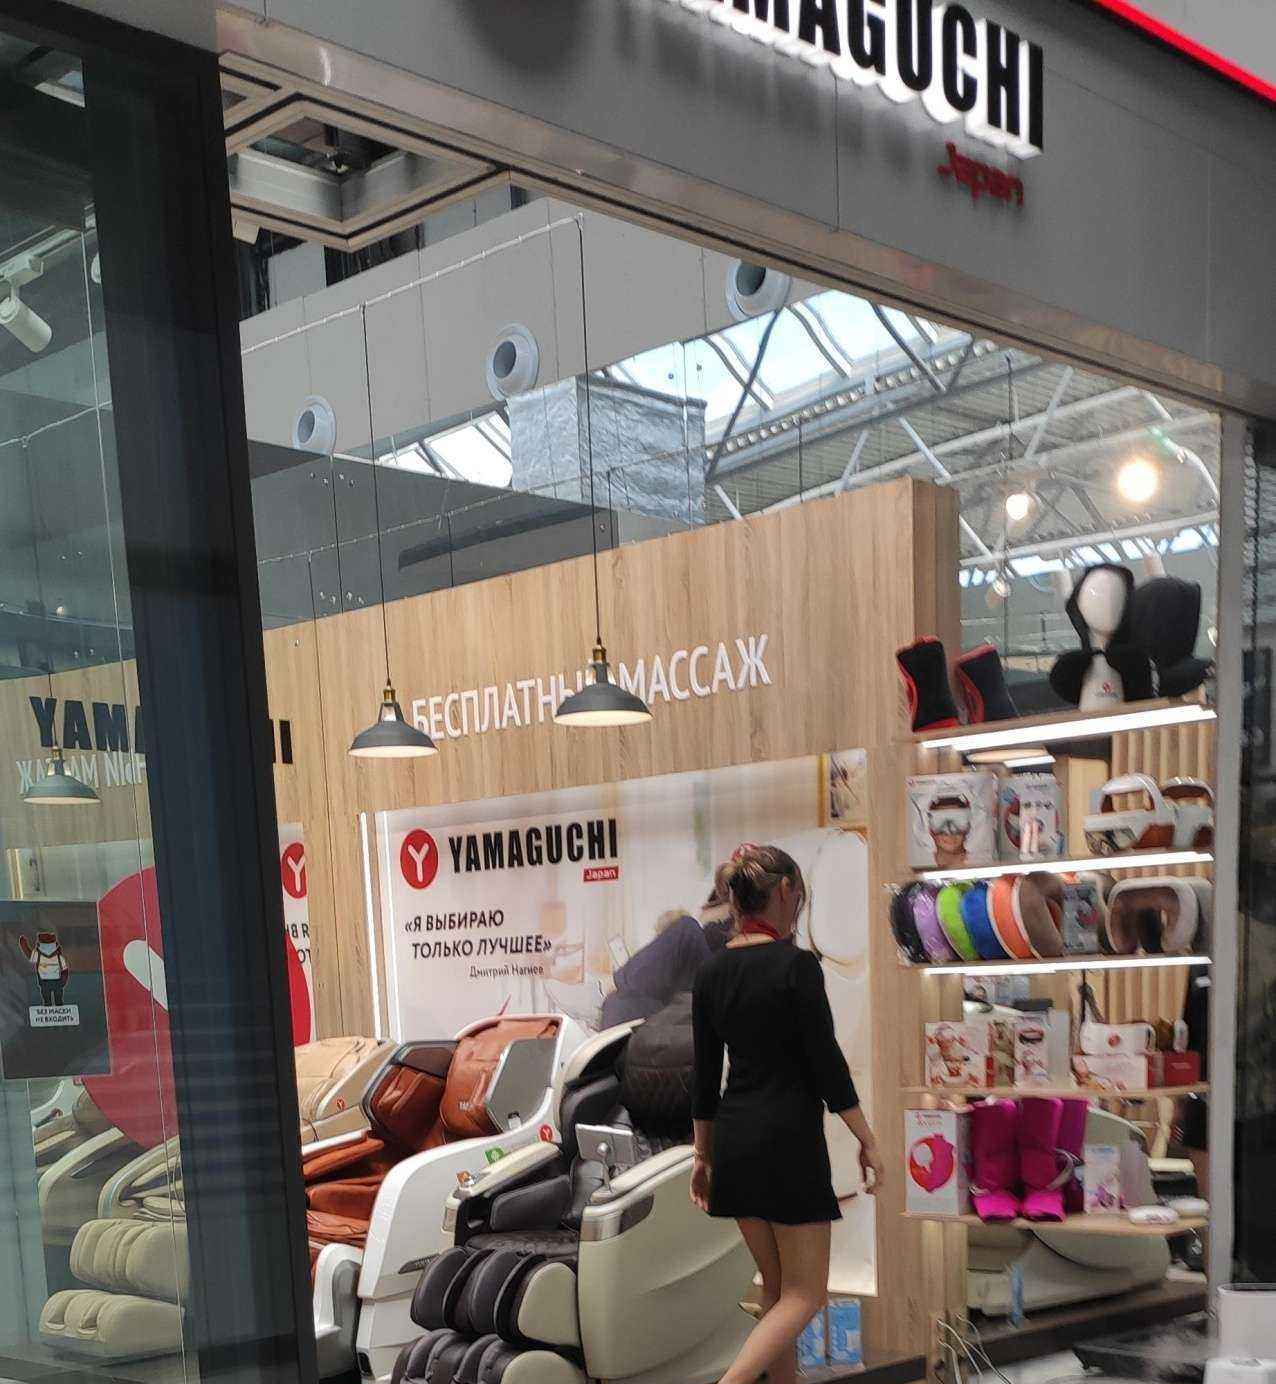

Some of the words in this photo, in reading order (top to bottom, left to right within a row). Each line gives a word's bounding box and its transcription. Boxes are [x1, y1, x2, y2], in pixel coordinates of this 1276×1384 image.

[618, 634, 773, 705] МАССАЖ
[29, 696, 145, 754] YAM
[448, 818, 619, 874] YAMAGUCHI
[586, 868, 617, 881] Japan
[405, 916, 422, 933] «Я
[425, 909, 505, 932] ВЫБИРАЮ
[412, 939, 474, 960] ТОЛЬКО
[477, 934, 552, 957] ЛУЧШЕЕ»
[469, 965, 510, 981] Дмитрий
